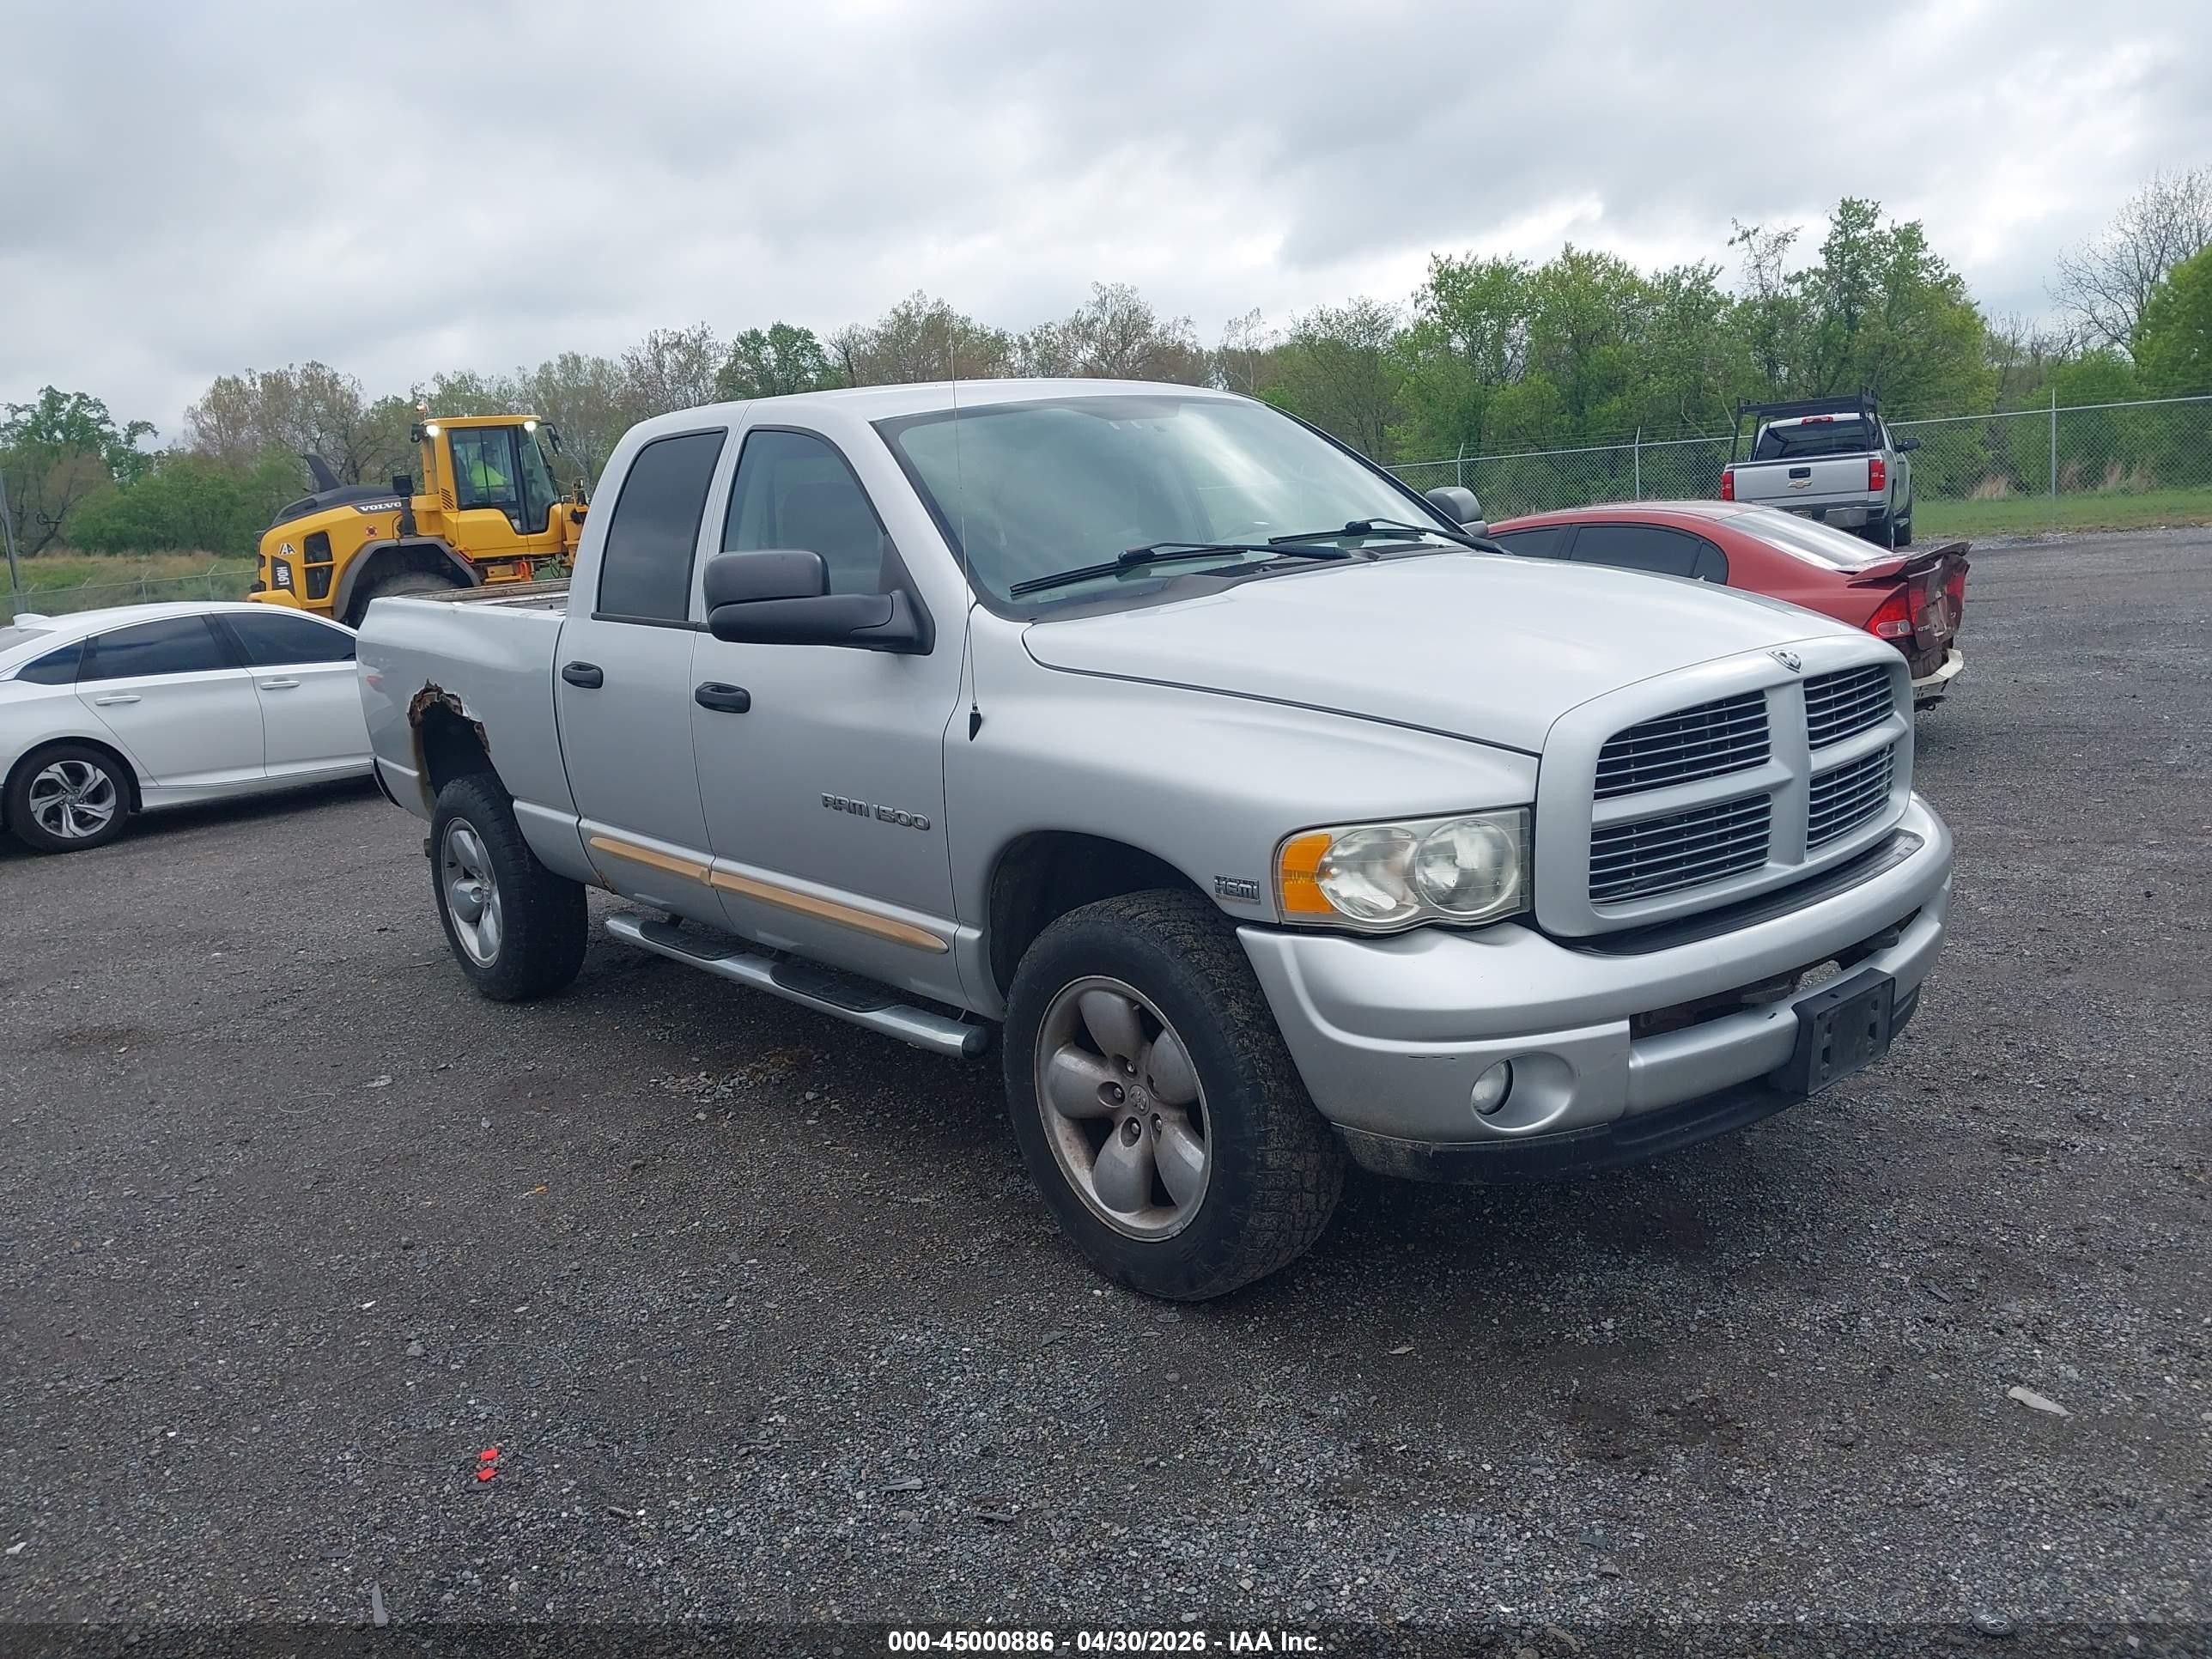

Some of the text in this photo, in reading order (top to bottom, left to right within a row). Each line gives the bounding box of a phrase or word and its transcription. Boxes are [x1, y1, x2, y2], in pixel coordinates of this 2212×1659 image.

[359, 501, 402, 512] VOLVO
[276, 566, 290, 586] L90H
[821, 792, 930, 831] RAM 1500
[1214, 878, 1260, 901] HEMI
